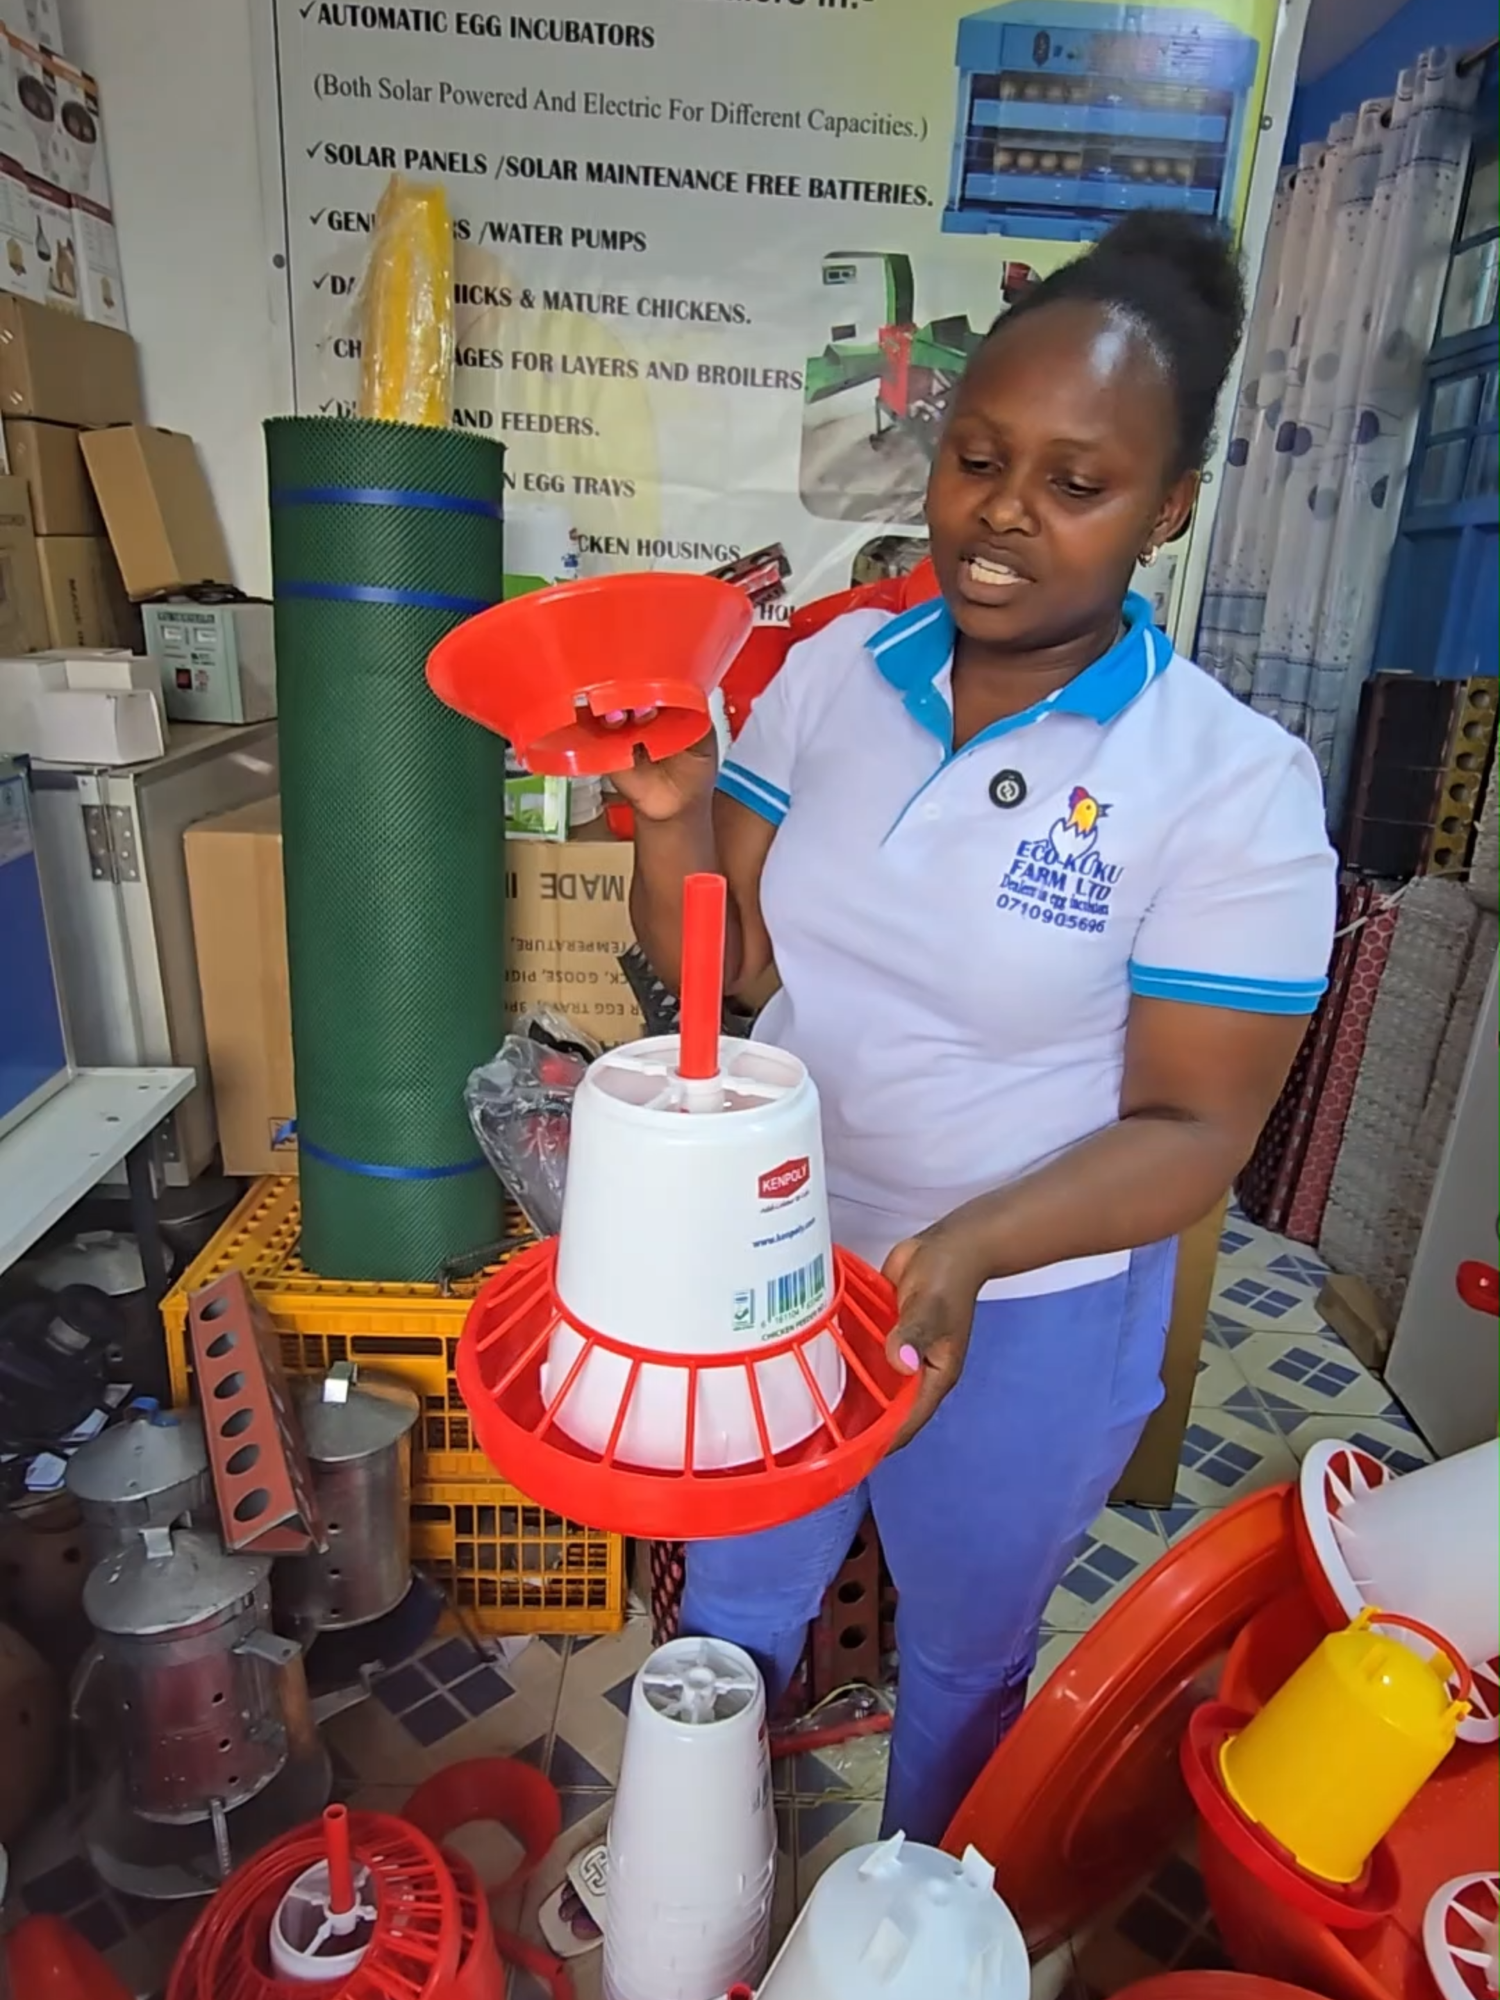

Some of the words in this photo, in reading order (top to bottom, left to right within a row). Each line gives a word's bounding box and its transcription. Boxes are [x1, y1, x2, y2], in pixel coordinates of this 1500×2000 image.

[317, 3, 448, 33] AUTOMATIC
[455, 12, 502, 38] EGG
[510, 16, 656, 49] INCUBATORS
[314, 73, 372, 100] (Both
[378, 77, 432, 103] Solar
[439, 82, 528, 110] Powered
[533, 89, 576, 113] And
[583, 92, 662, 119] Electric
[669, 98, 704, 122] For
[711, 101, 801, 129] Different
[808, 109, 928, 141] Capacities.)
[324, 142, 396, 169] SOLAR
[404, 148, 487, 175] PANELS
[495, 155, 578, 182] /SOLAR
[586, 162, 739, 193] MAINTENANCE
[747, 173, 801, 197] FREE
[808, 178, 934, 207] BATTERIES.
[478, 219, 563, 247] /WATER
[572, 227, 647, 252] PUMPS
[519, 289, 536, 310] &
[543, 290, 630, 317] MATURE
[637, 297, 752, 324] CHICKENS.
[512, 350, 554, 373] FOR
[562, 356, 639, 380] LAYERS
[646, 360, 689, 382] AND
[452, 408, 493, 429] AND
[500, 410, 600, 437] FEEDERS.
[523, 472, 565, 493] EGG
[572, 476, 636, 498] TRAYS
[637, 539, 741, 562] HOUSINGS
[540, 873, 624, 902] MADE
[1009, 859, 1067, 892] FARM
[1075, 877, 1112, 902] LTD
[996, 893, 1107, 933] 0710905696
[542, 968, 599, 985] GOOSE,
[594, 1002, 625, 1016] EGG
[761, 1164, 808, 1193] KENPOLY
